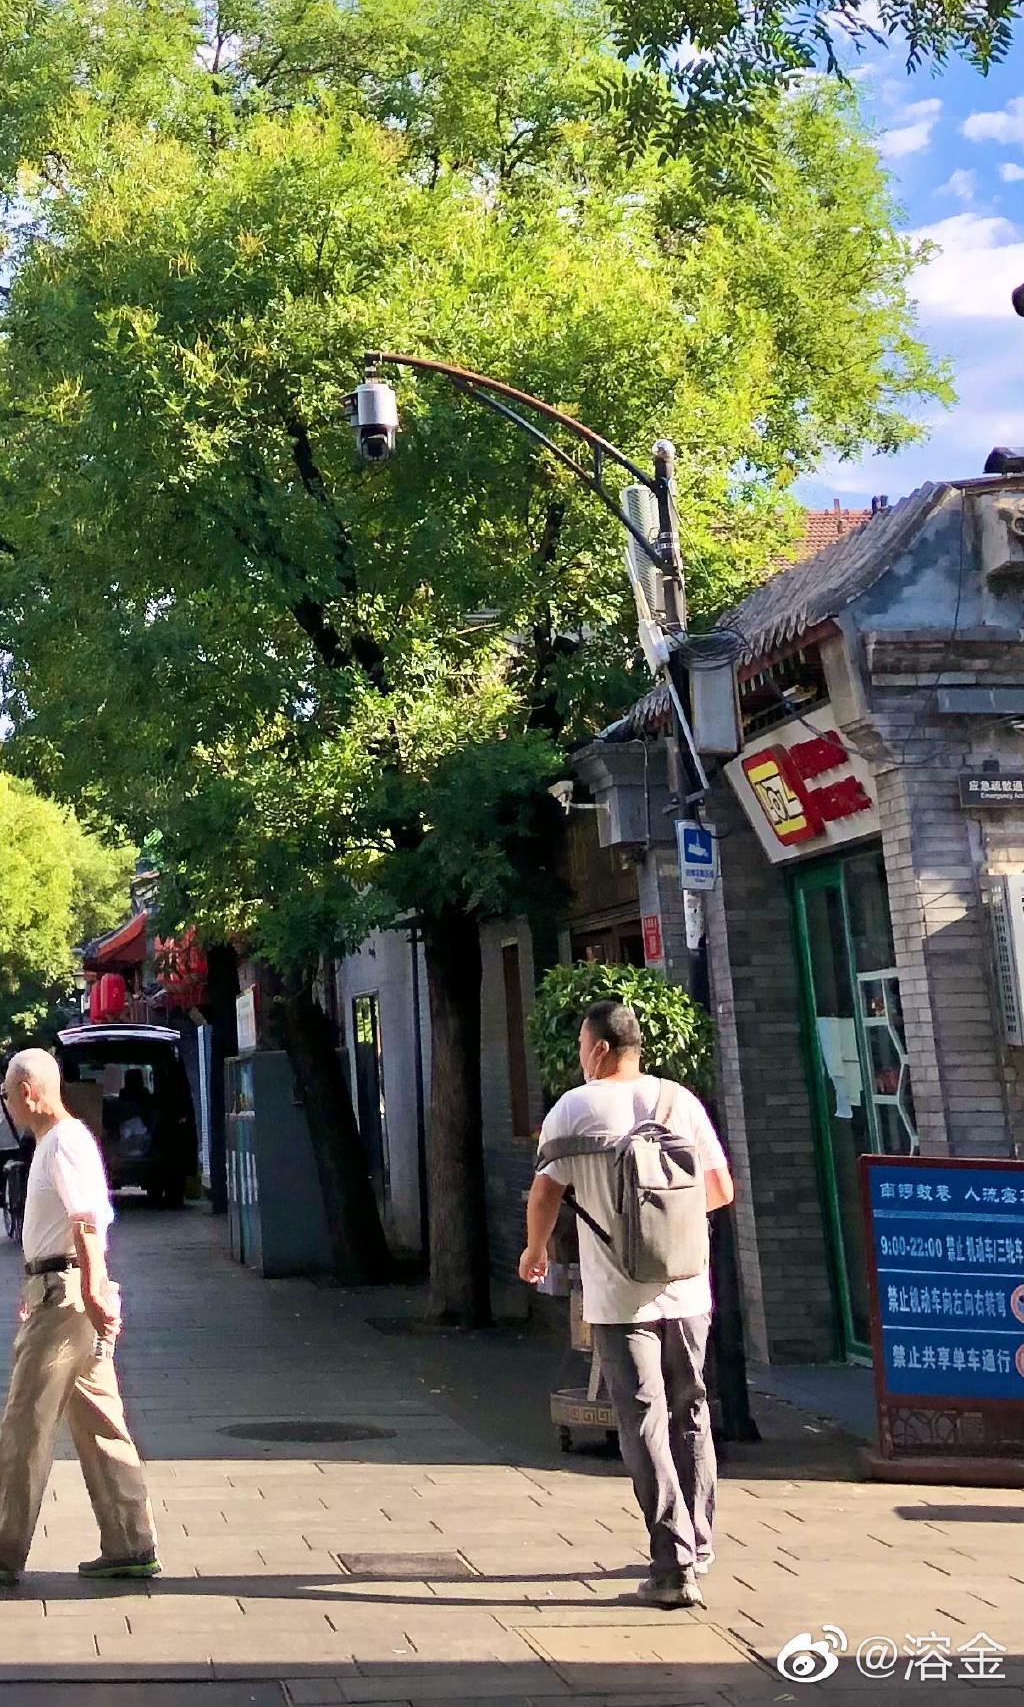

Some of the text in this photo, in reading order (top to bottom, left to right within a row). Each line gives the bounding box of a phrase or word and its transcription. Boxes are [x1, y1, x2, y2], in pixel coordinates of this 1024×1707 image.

[879, 1182, 952, 1202] 南锣鼓巷
[880, 1235, 943, 1258] 9:00-22:00
[887, 1284, 1007, 1318] 禁止机动车向左向右转弯
[892, 1344, 1011, 1374] 禁止共享单车通行
